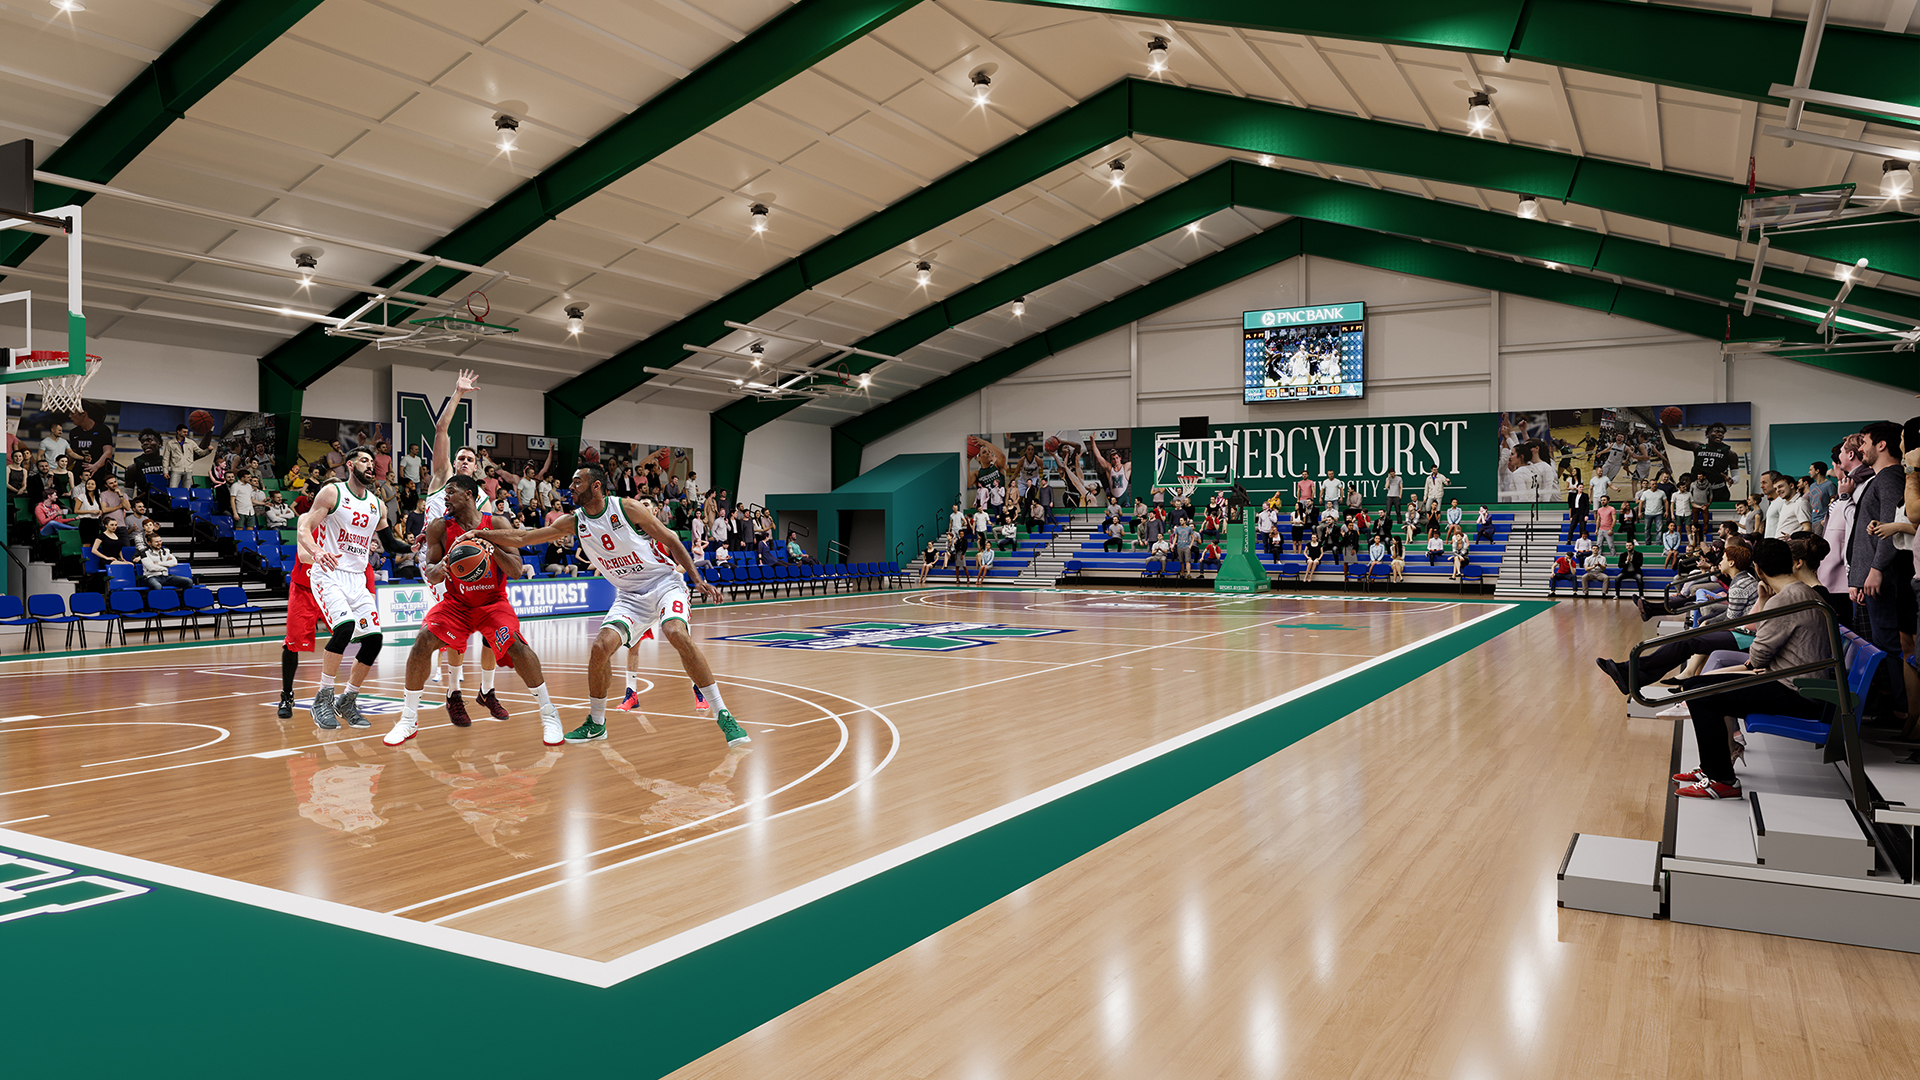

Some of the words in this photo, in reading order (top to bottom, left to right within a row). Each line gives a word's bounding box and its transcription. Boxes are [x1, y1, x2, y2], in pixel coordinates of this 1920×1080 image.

[1277, 311, 1305, 323] PNC
[1306, 307, 1344, 320] BANK
[1266, 389, 1277, 397] 55
[1329, 386, 1340, 394] 40
[1703, 458, 1715, 467] 23
[352, 511, 370, 528] 23
[601, 534, 615, 551] 8
[514, 605, 553, 615] UNIVERSITY
[672, 600, 683, 613] 8
[496, 626, 510, 646] 42
